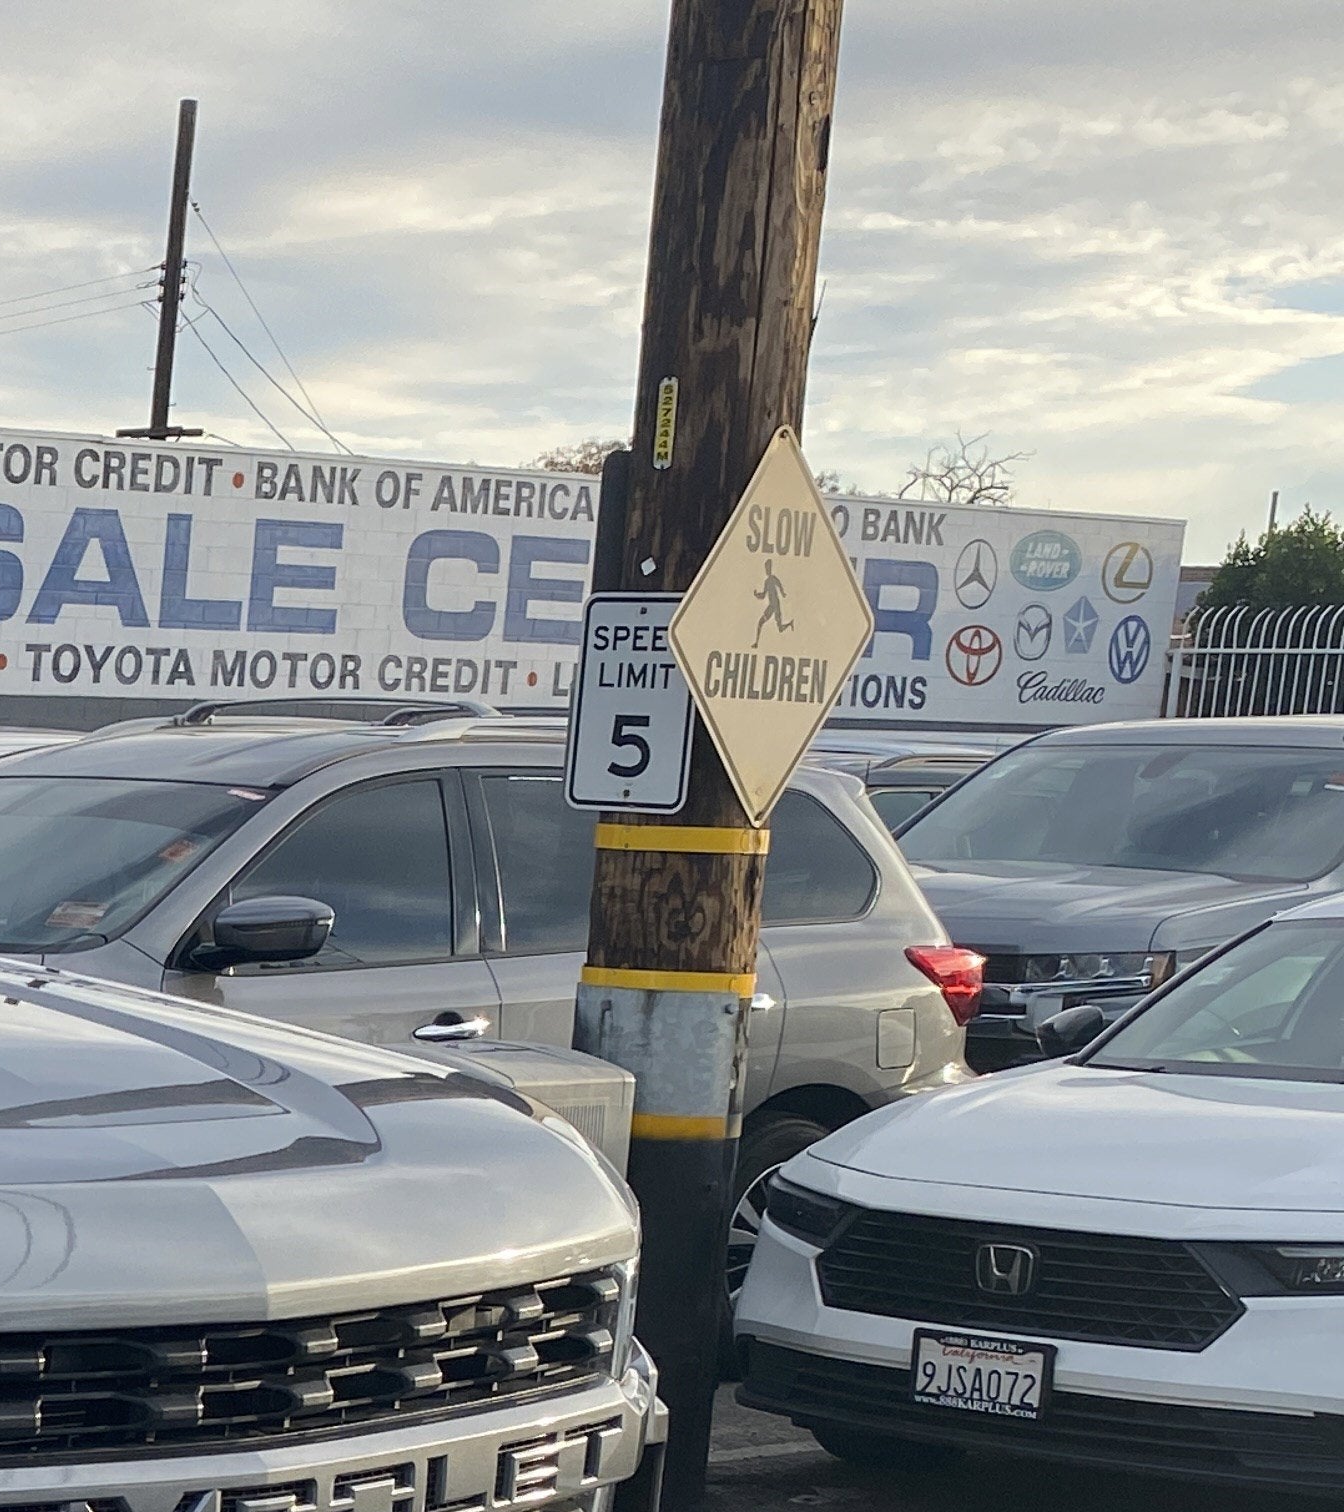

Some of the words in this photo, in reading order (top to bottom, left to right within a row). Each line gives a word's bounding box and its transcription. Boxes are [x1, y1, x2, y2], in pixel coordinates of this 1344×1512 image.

[73, 447, 223, 498] CREDIT
[255, 460, 361, 507] BANK
[375, 469, 422, 511] OF
[430, 473, 595, 522] AMERICA
[746, 504, 817, 558] SLOW
[861, 507, 948, 546] BANK
[593, 625, 669, 651] SPEE
[24, 643, 197, 688] TOYOTA
[210, 650, 362, 692] MOTOR
[377, 655, 518, 697] CREDIT
[598, 662, 676, 689] LIMIT
[703, 651, 829, 704] CHILDREN
[1016, 671, 1105, 704] Cadillac
[607, 714, 651, 778] 5
[970, 1339, 1017, 1353] KARPLUS
[920, 1361, 1037, 1408] 9JSA072
